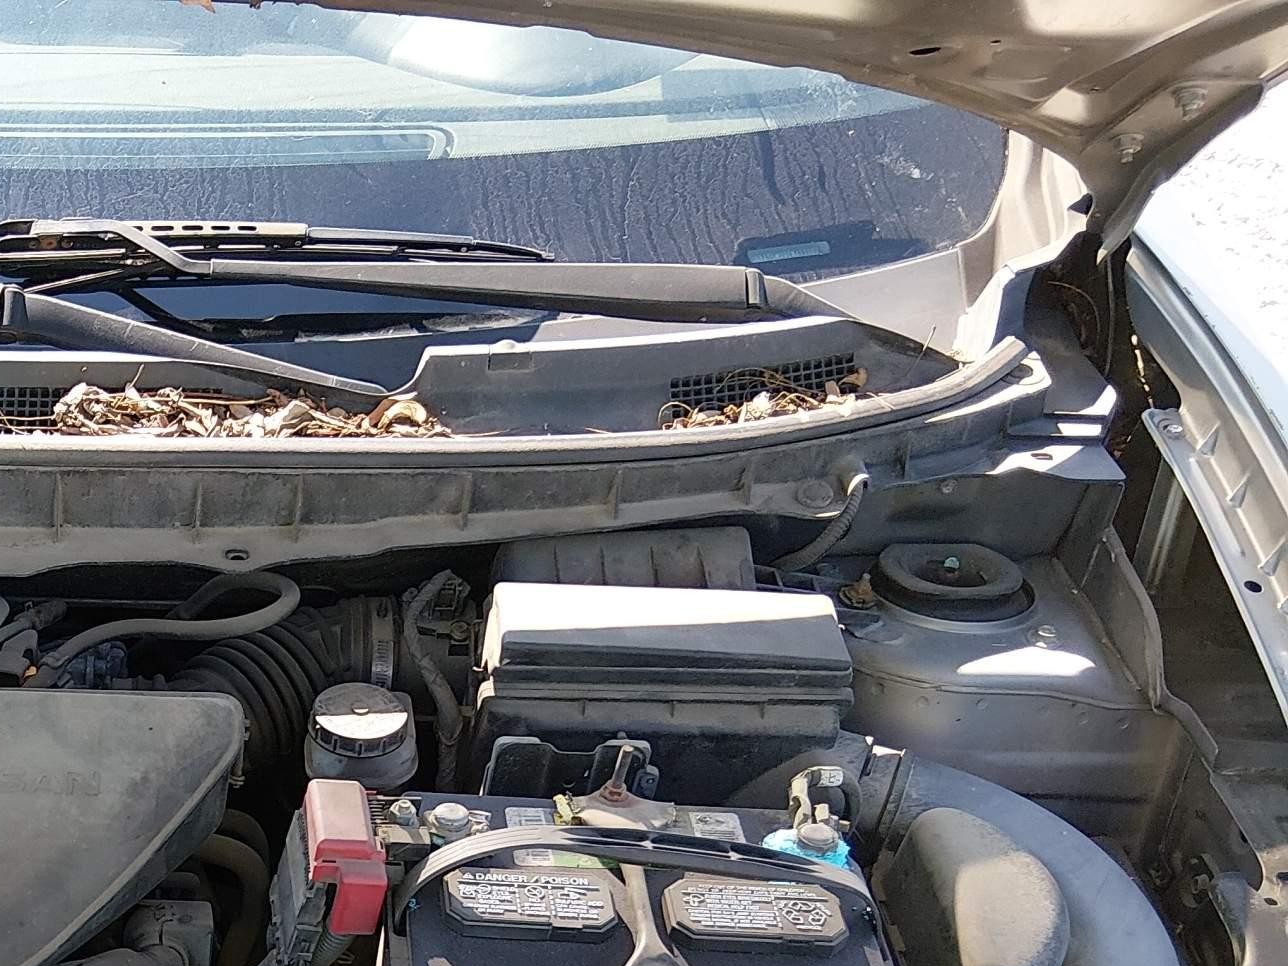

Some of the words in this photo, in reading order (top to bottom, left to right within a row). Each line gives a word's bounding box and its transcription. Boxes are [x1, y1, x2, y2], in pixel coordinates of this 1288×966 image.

[475, 872, 527, 882] DANGER
[530, 875, 539, 883] /
[541, 876, 589, 886] POISON
